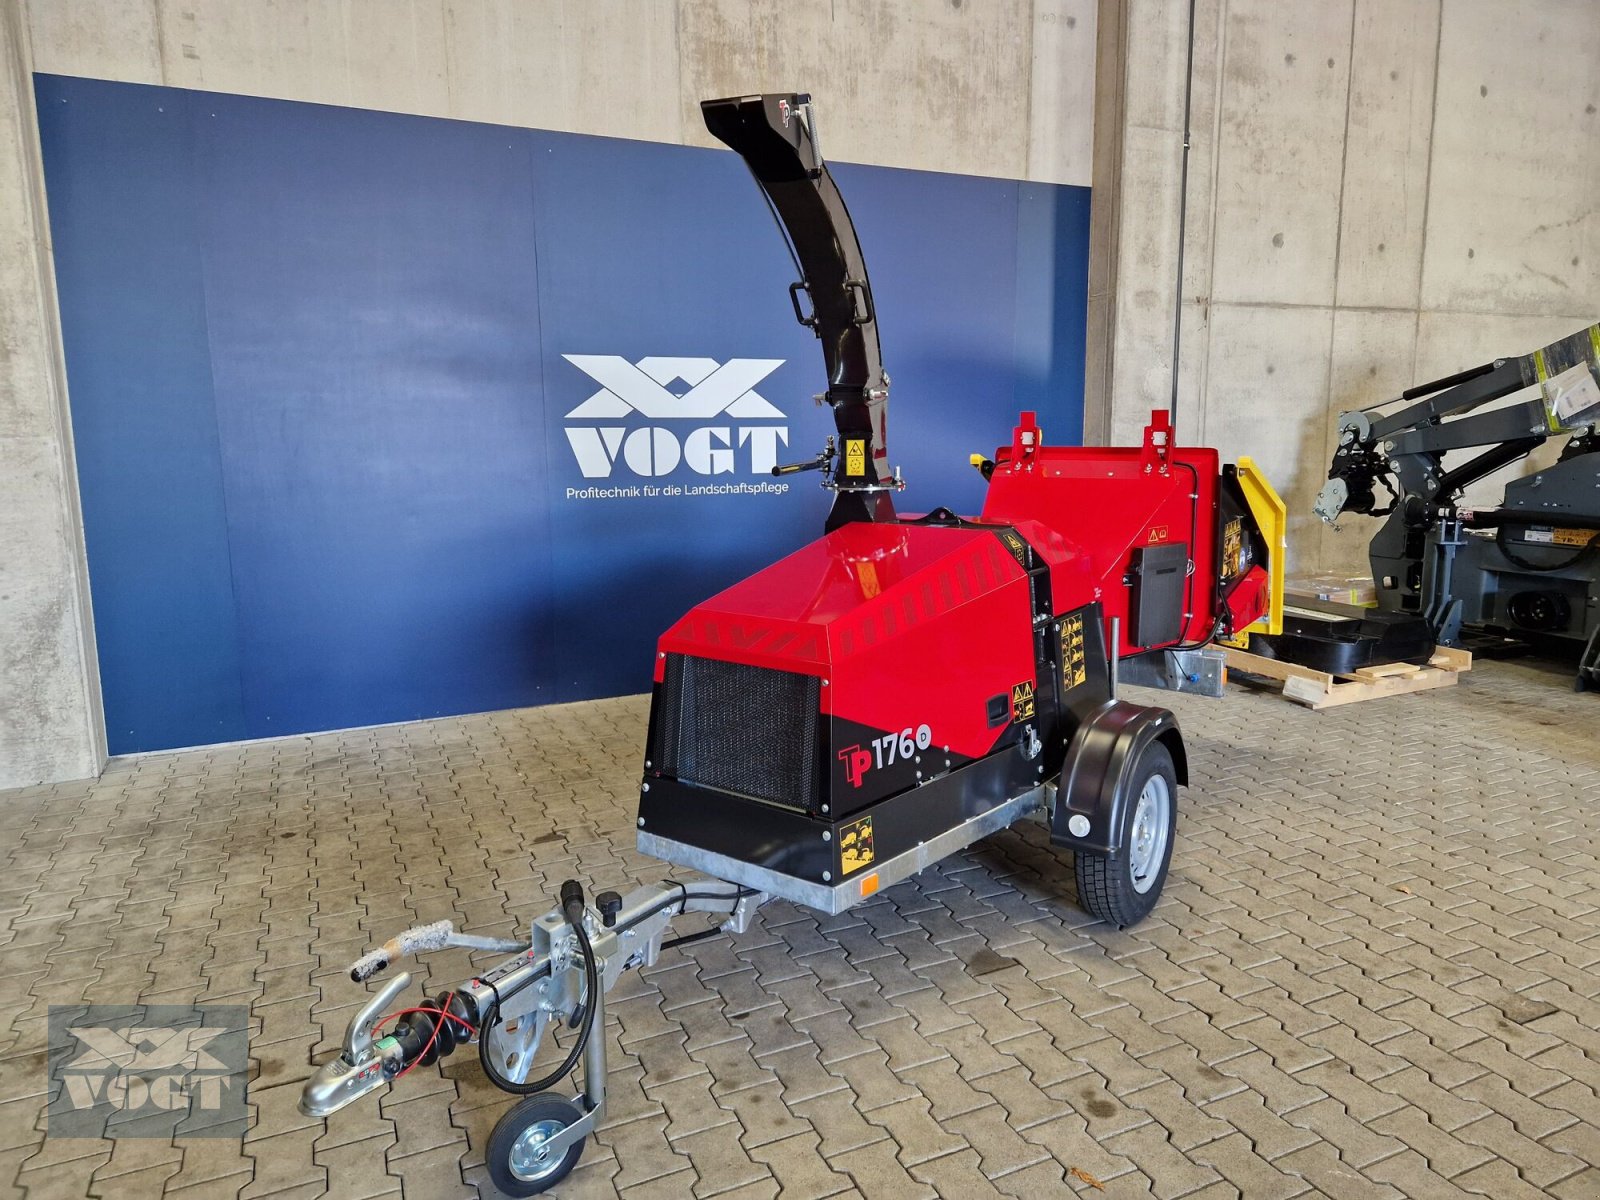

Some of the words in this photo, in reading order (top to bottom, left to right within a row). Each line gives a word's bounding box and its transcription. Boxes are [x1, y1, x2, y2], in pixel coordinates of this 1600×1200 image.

[564, 427, 789, 478] VOGT
[566, 486, 640, 499] Profitechnik
[643, 484, 660, 497] für
[663, 484, 681, 496] die
[684, 481, 789, 496] Landschaftspflege
